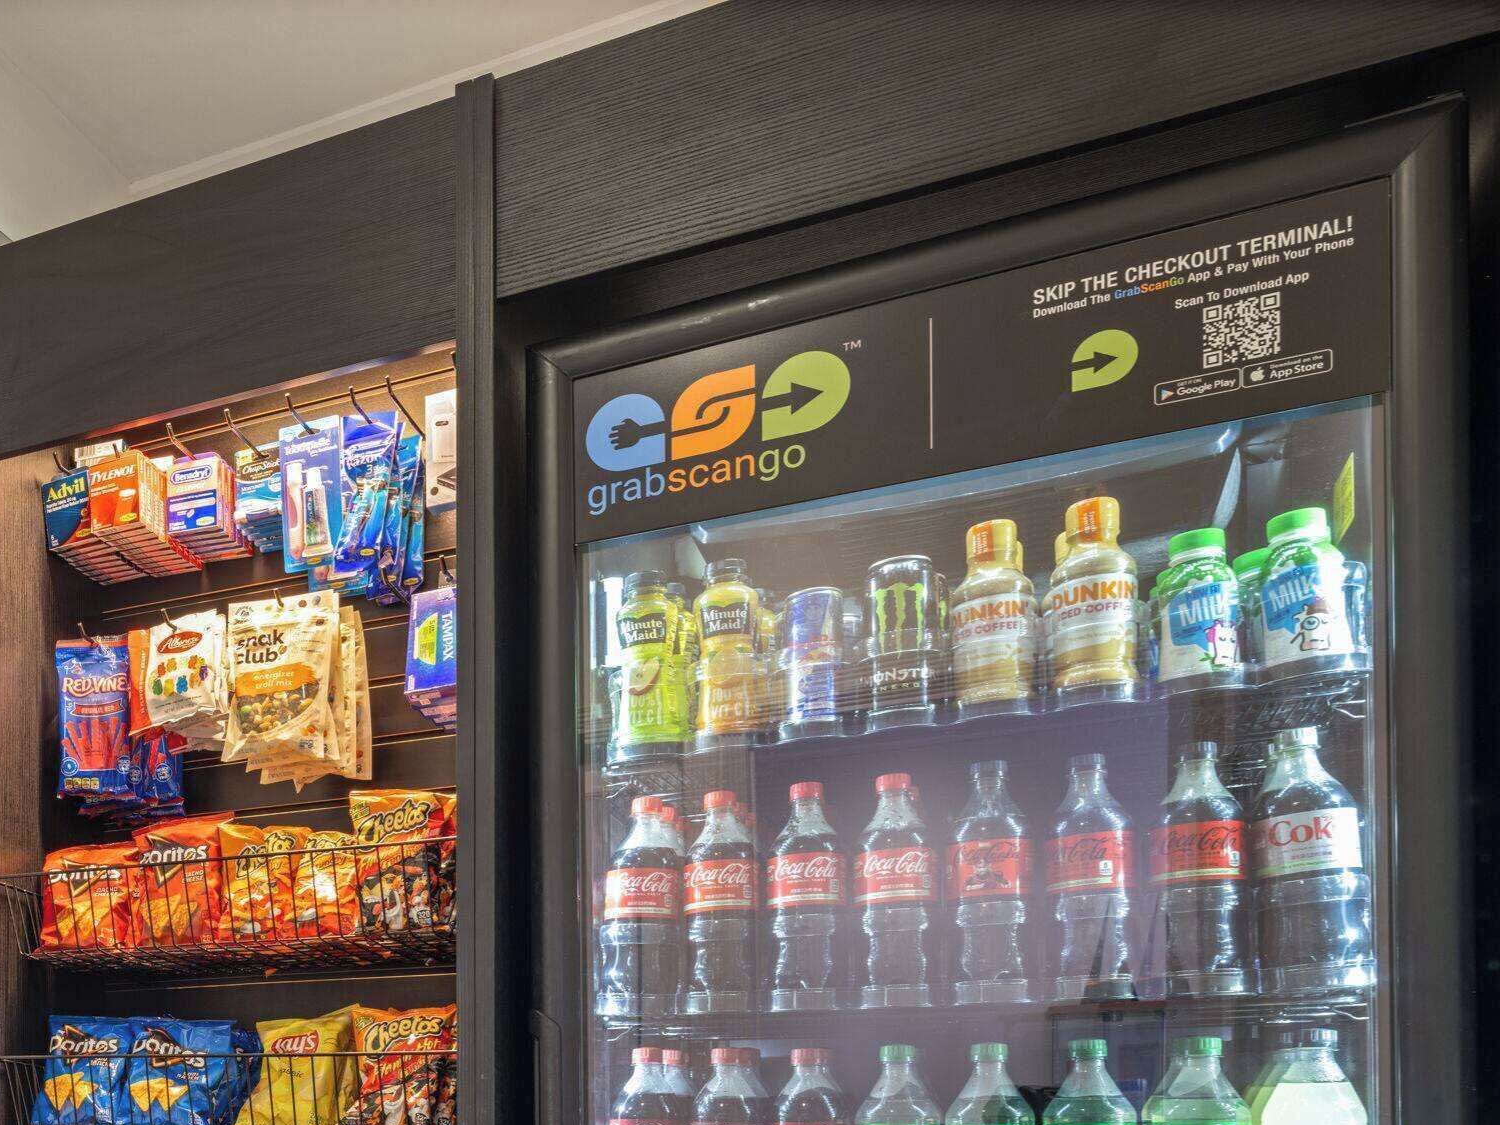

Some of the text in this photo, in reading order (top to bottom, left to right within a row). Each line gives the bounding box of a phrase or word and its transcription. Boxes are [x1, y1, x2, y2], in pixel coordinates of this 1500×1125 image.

[1033, 215, 1354, 305] SKIP THE CHECKOUT TERMINAL!
[1033, 236, 1355, 319] Download The GrabScanGo App & Pay With Your Phone
[1174, 271, 1310, 310] Scan To Download App
[1269, 360, 1325, 381] App Store
[1176, 378, 1237, 397] Google Play
[91, 463, 136, 486] TYLENOL
[586, 443, 807, 516] grabscango
[46, 476, 86, 503] Advil
[620, 619, 663, 633] Minute
[702, 607, 748, 622] Minute
[709, 618, 742, 633] Maid
[236, 629, 285, 651] snak
[442, 610, 455, 661] TAMPAX
[625, 628, 658, 643] Maid
[235, 648, 279, 665] club
[358, 797, 432, 852] Cheetos
[690, 863, 750, 889] Coca-Cola
[775, 856, 838, 883] Coca-Cola
[864, 851, 931, 879] Coca-Cola
[619, 871, 672, 896] Coca-Cola
[49, 1034, 119, 1054] Doritos
[363, 1014, 444, 1062] Cheetos
